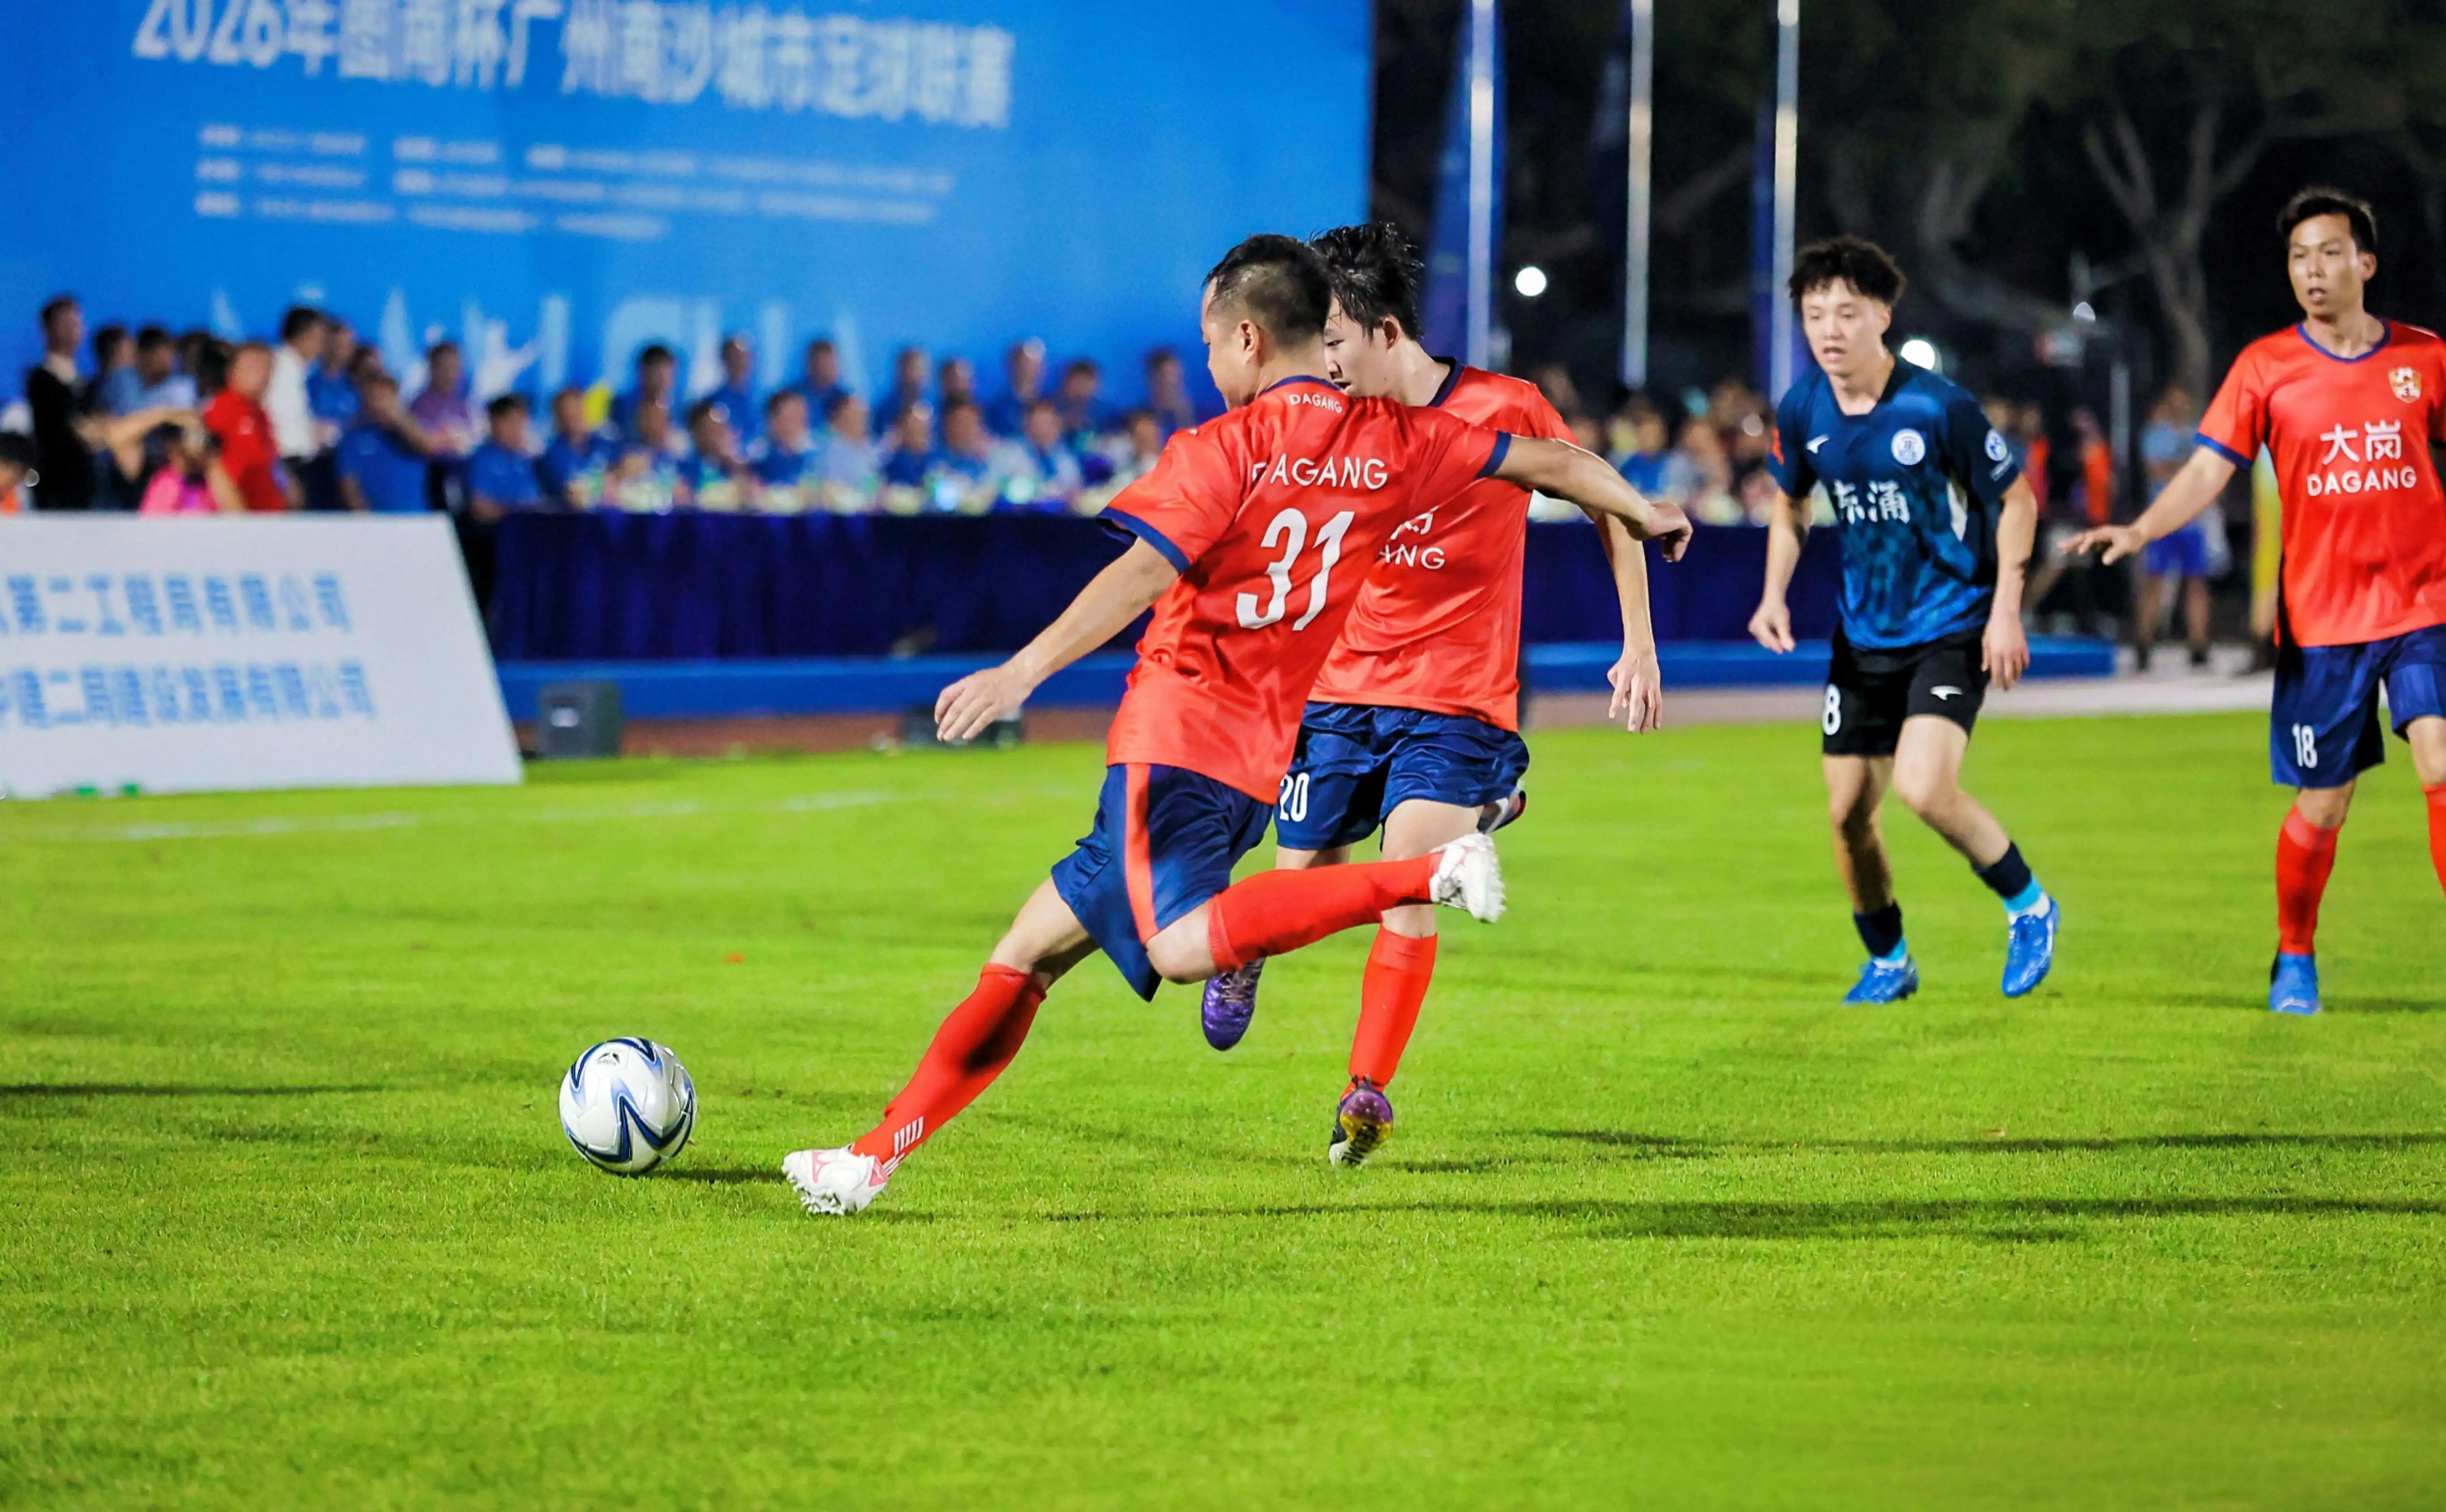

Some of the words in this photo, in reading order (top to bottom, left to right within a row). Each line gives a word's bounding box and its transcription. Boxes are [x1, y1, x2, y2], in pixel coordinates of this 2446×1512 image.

[1289, 393, 1342, 413] DAGANG
[2319, 419, 2401, 465] 大岗
[2307, 466, 2417, 497] DAGANG
[1236, 508, 1355, 632] 31
[2292, 722, 2318, 768] 18
[1279, 772, 1310, 822] 20
